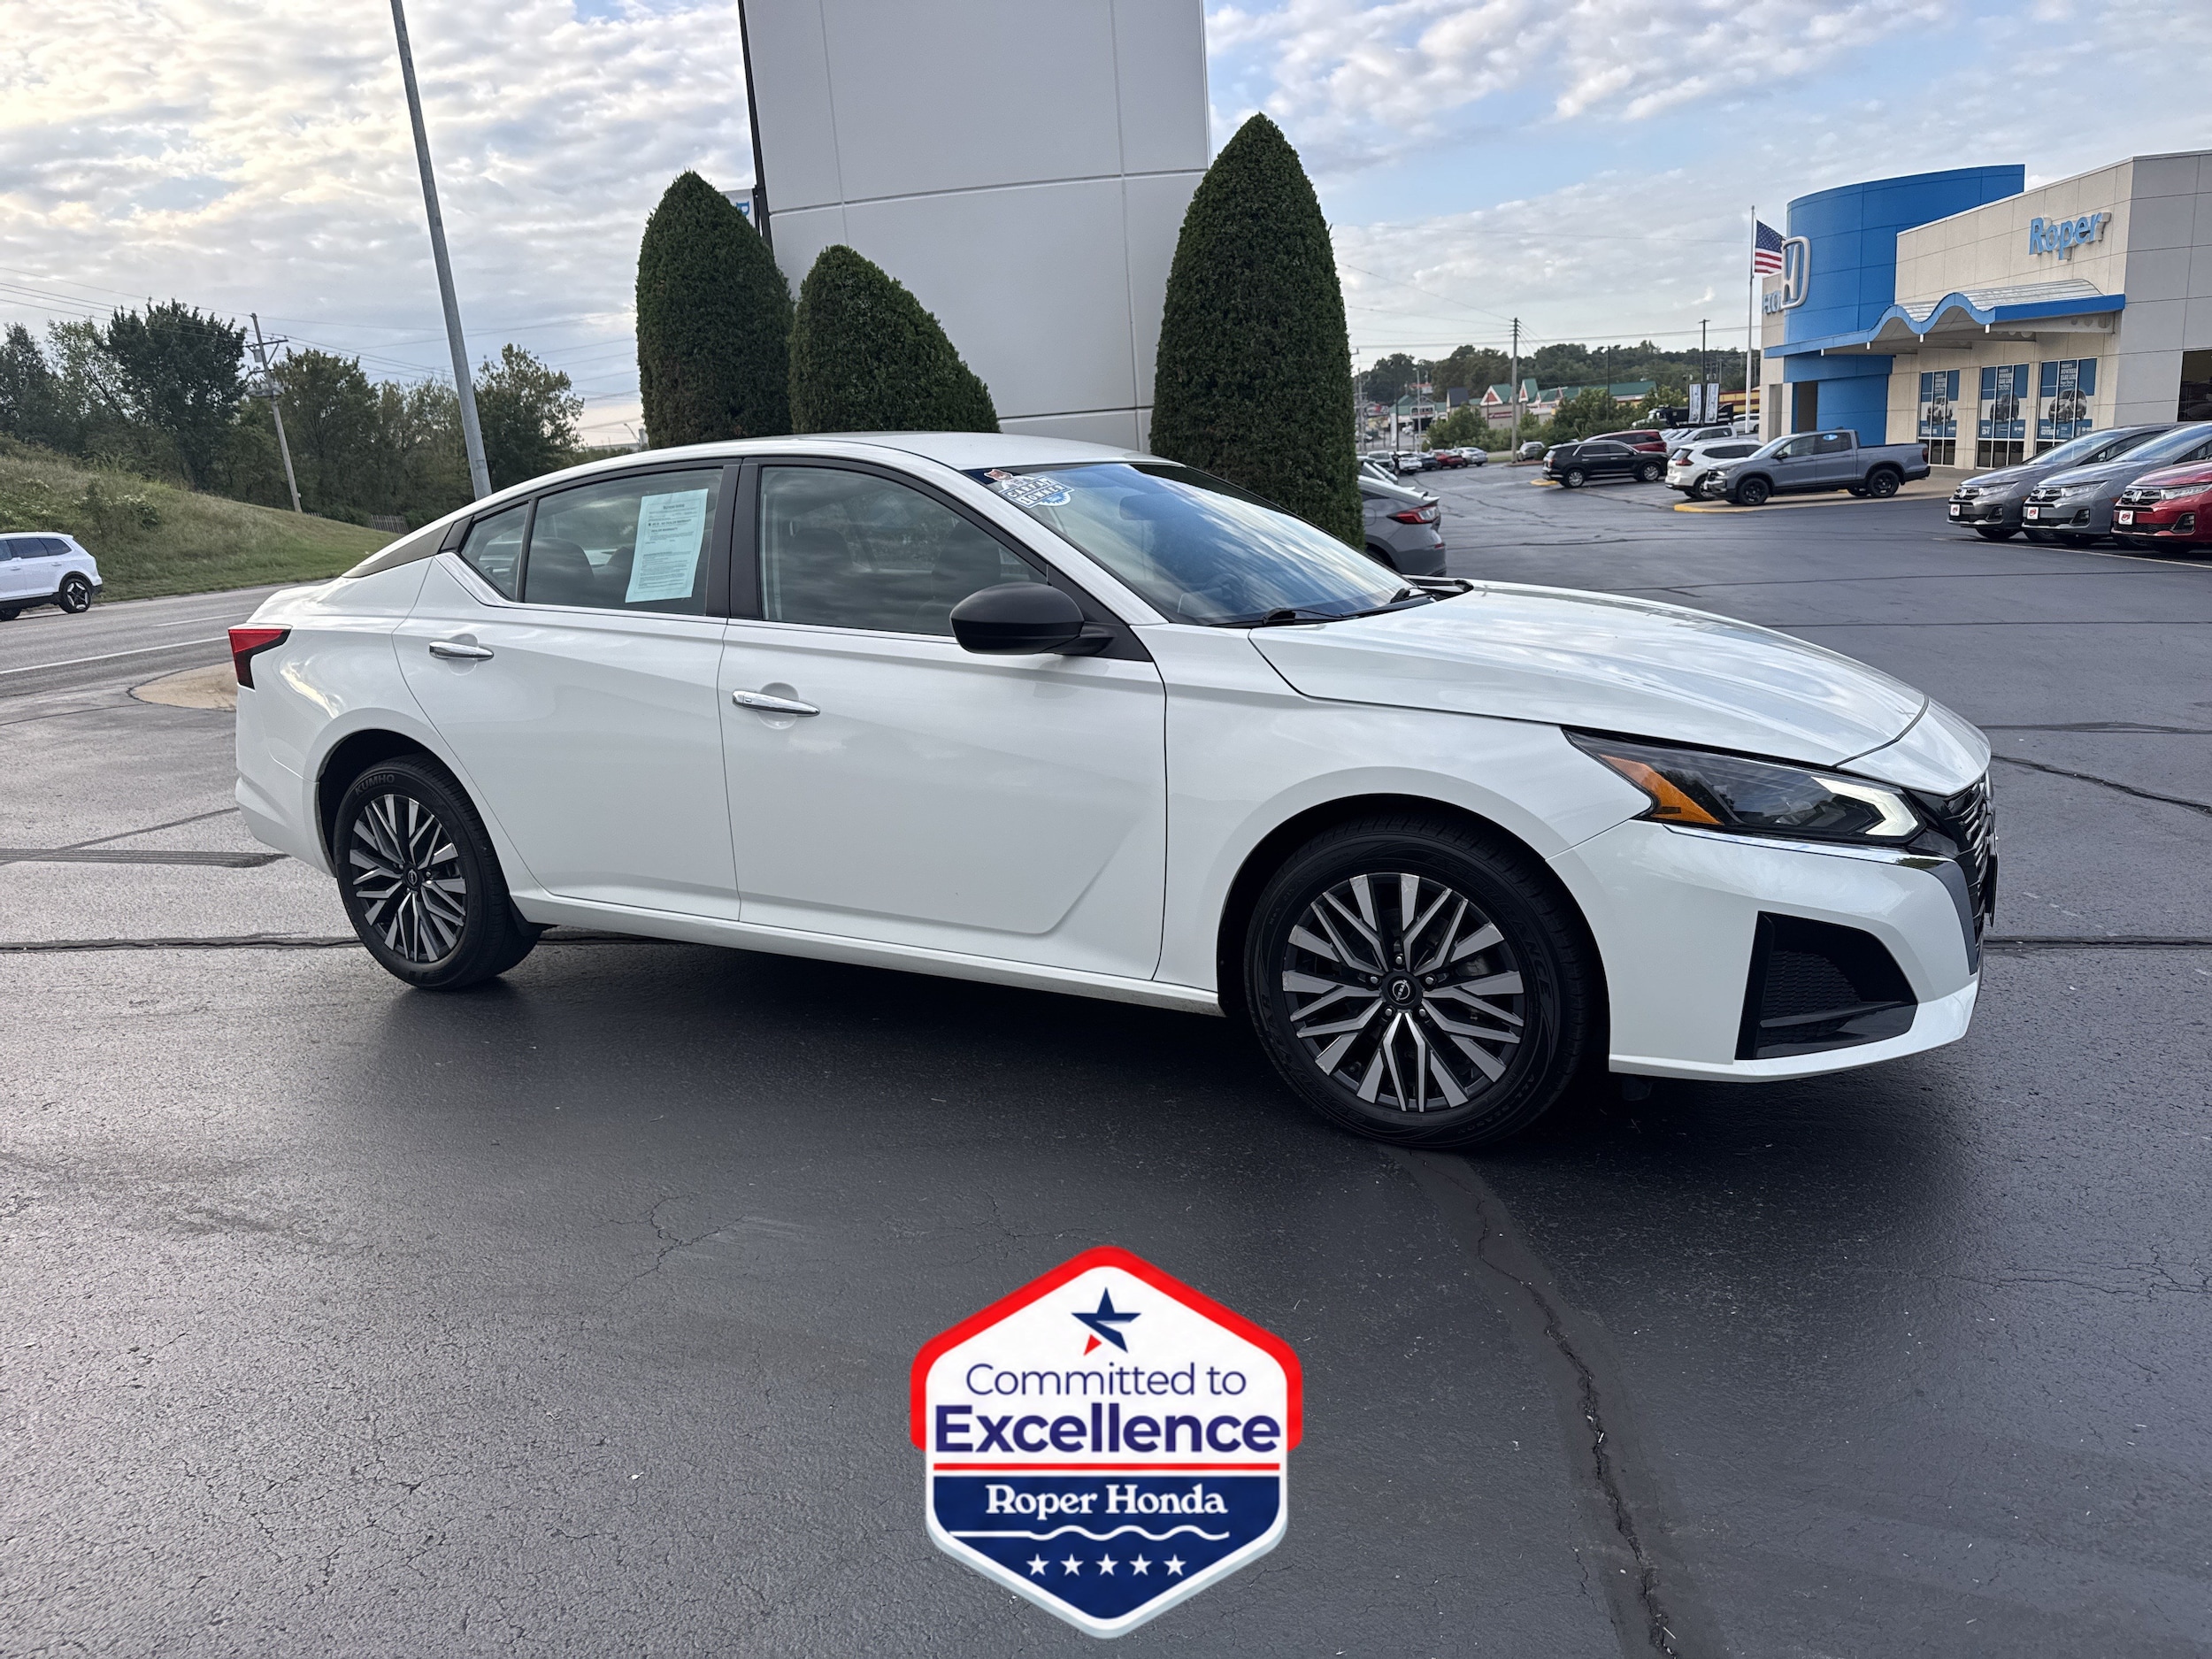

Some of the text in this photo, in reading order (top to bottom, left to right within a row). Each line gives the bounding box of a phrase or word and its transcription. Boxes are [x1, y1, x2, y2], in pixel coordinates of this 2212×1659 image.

[2029, 212, 2108, 261] Roper
[1007, 478, 1053, 497] CARFAX
[1027, 485, 1066, 501] OWNER
[355, 773, 395, 795] KUMHO
[1425, 856, 1554, 999] ASSURANCE
